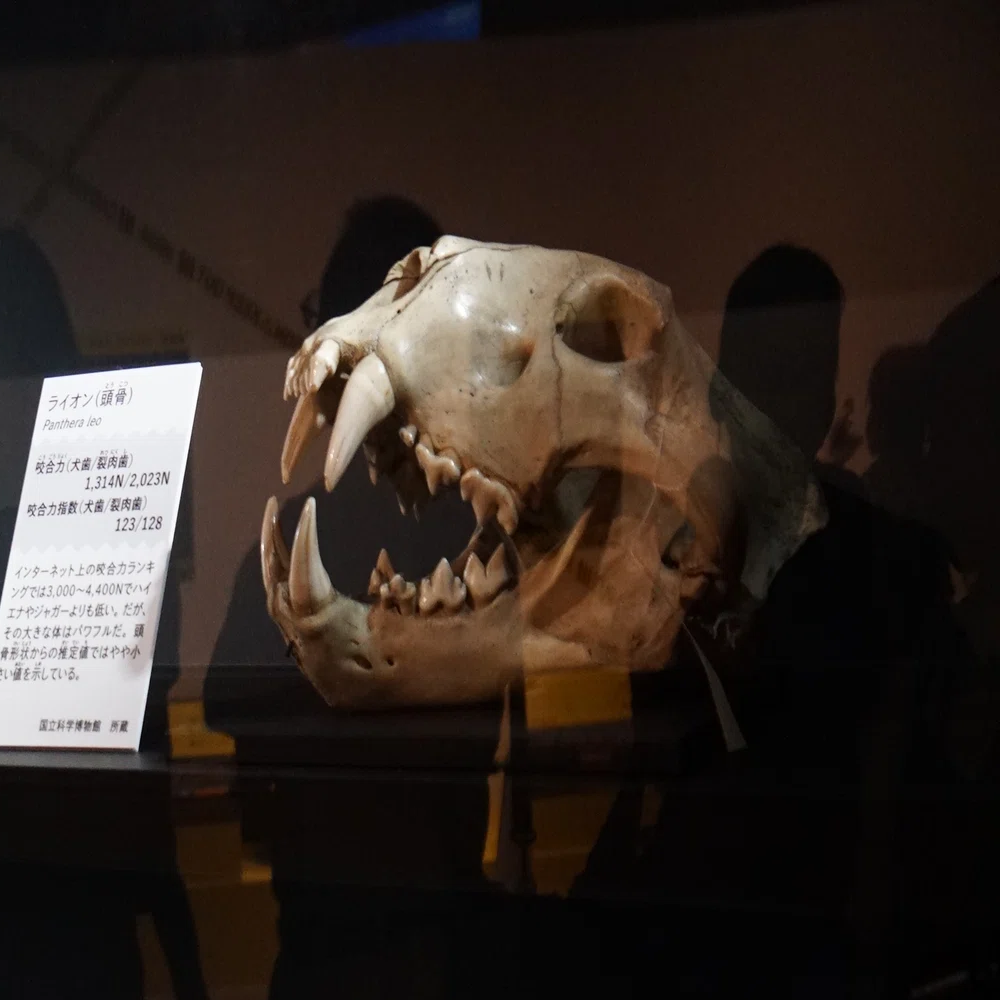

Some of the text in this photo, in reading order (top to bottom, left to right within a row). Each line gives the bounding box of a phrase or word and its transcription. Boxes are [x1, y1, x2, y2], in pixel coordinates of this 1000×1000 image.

[48, 386, 134, 413] ライオン(頭骨)
[41, 415, 103, 432] Panthera leo
[84, 470, 171, 492] 1,314N/2,023N
[114, 515, 164, 533] 123/128
